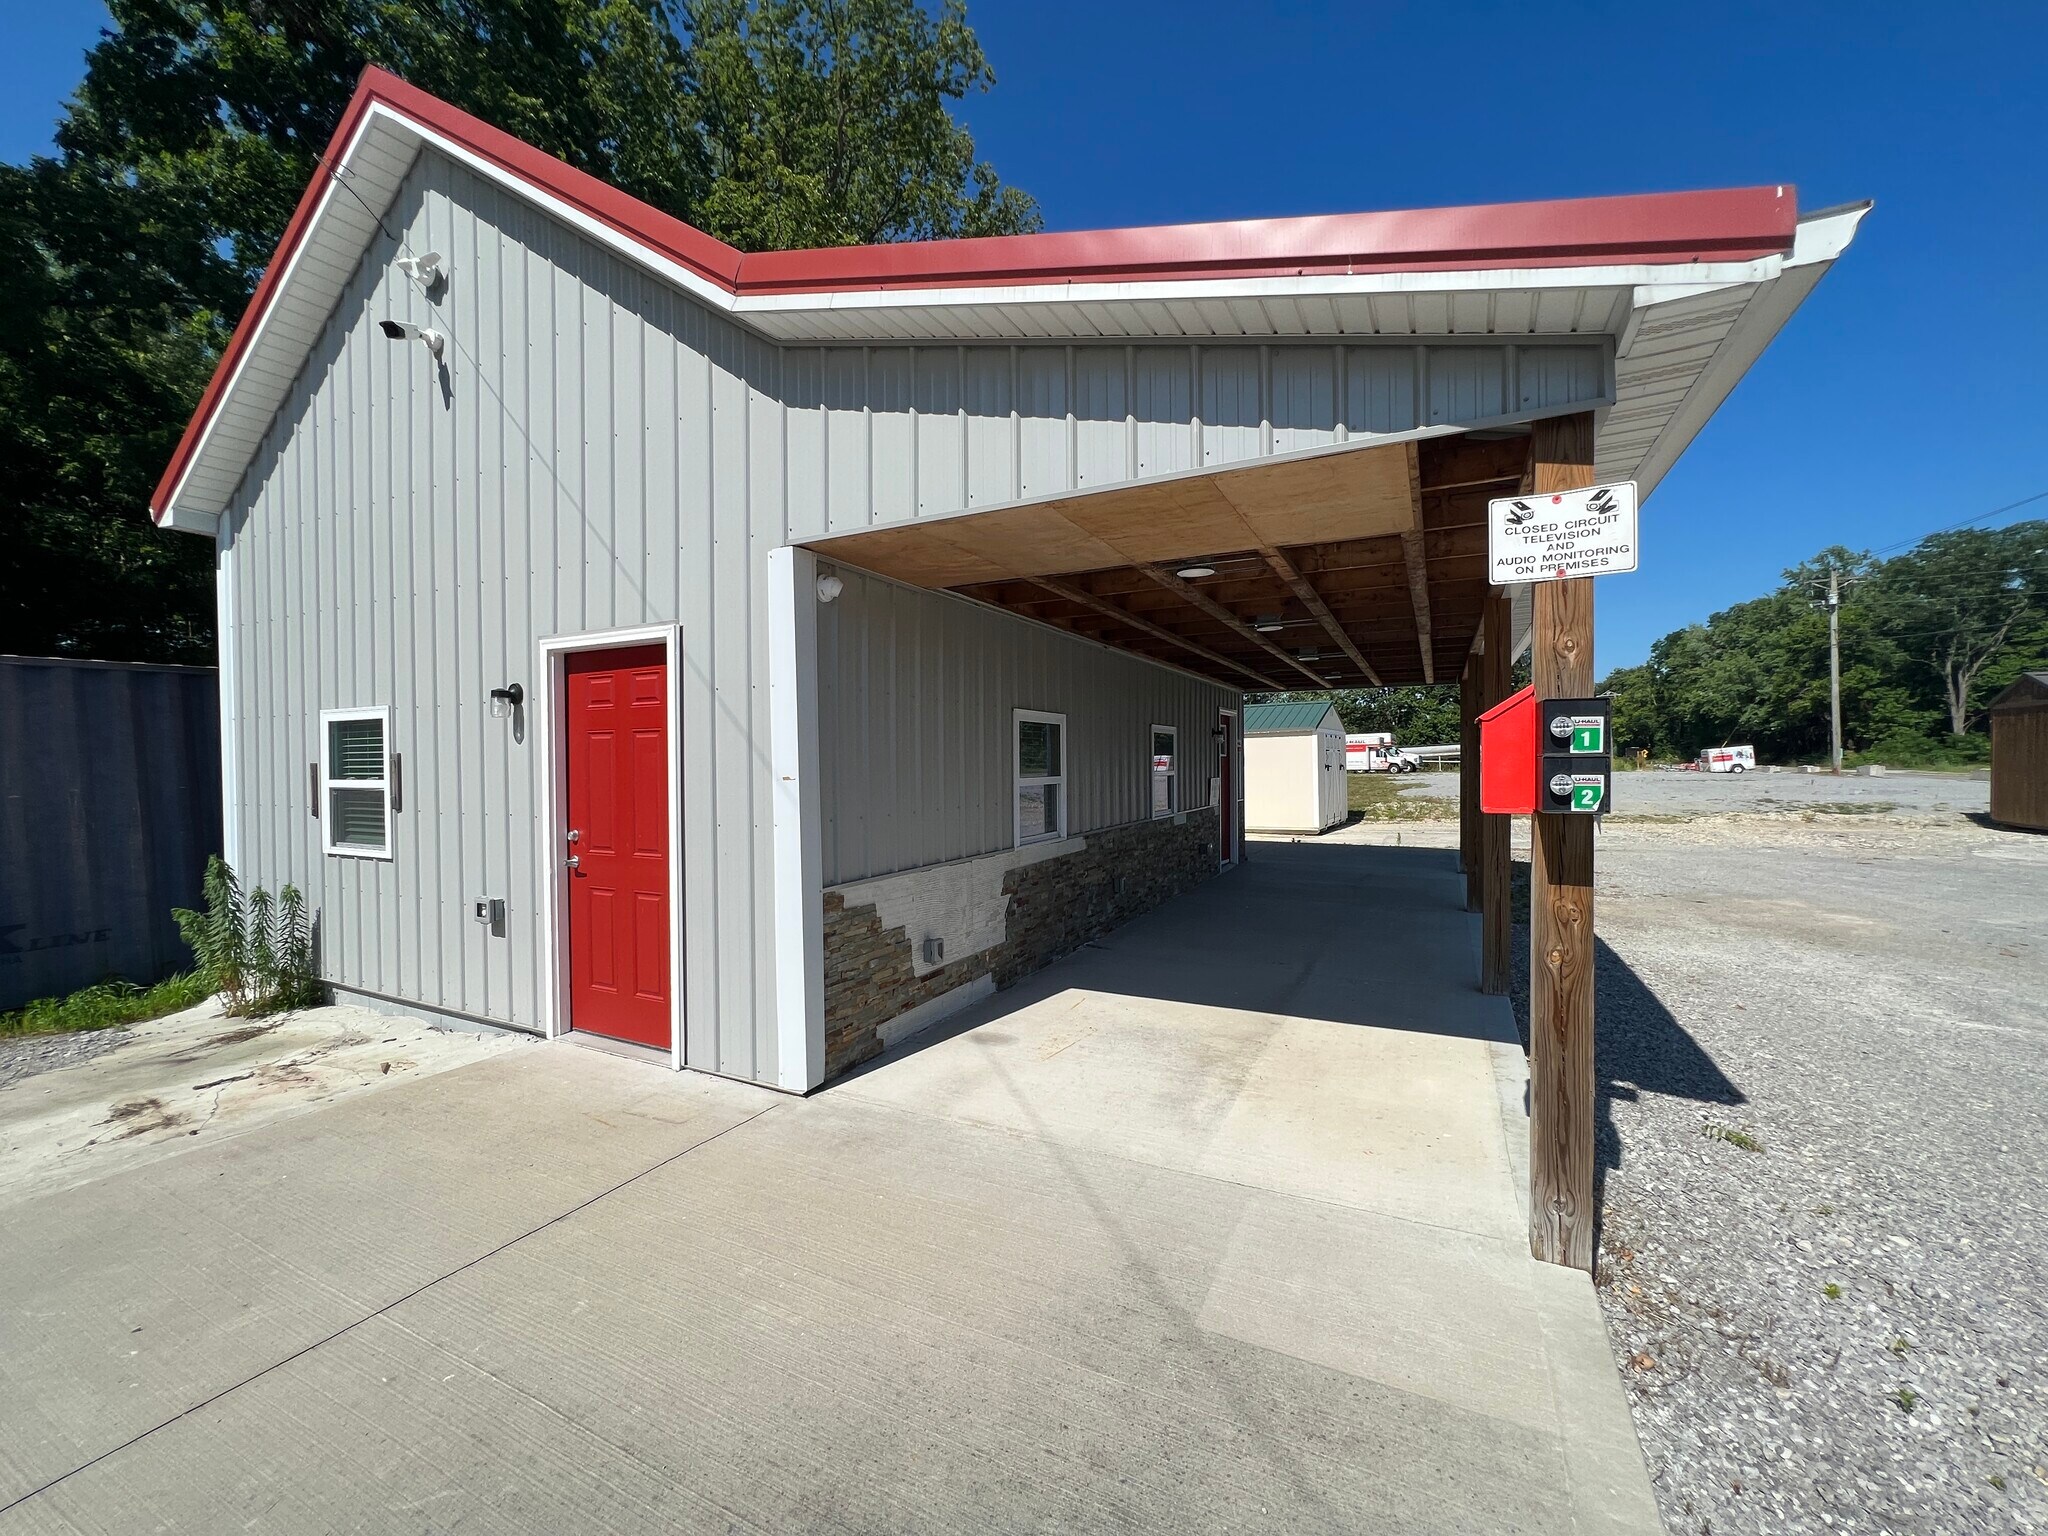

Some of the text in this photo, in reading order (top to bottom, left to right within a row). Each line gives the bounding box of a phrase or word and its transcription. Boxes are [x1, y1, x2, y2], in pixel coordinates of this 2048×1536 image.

[1504, 514, 1620, 536] CLOSED CIRCUIT
[1522, 528, 1601, 544] TELEVISION
[1546, 541, 1575, 552] AND
[1497, 544, 1630, 567] AUDIO MONITORING
[1515, 557, 1609, 575] ON PREMISES
[1580, 731, 1591, 747] 1
[1581, 789, 1594, 805] 2
[25, 928, 113, 951] LINE
